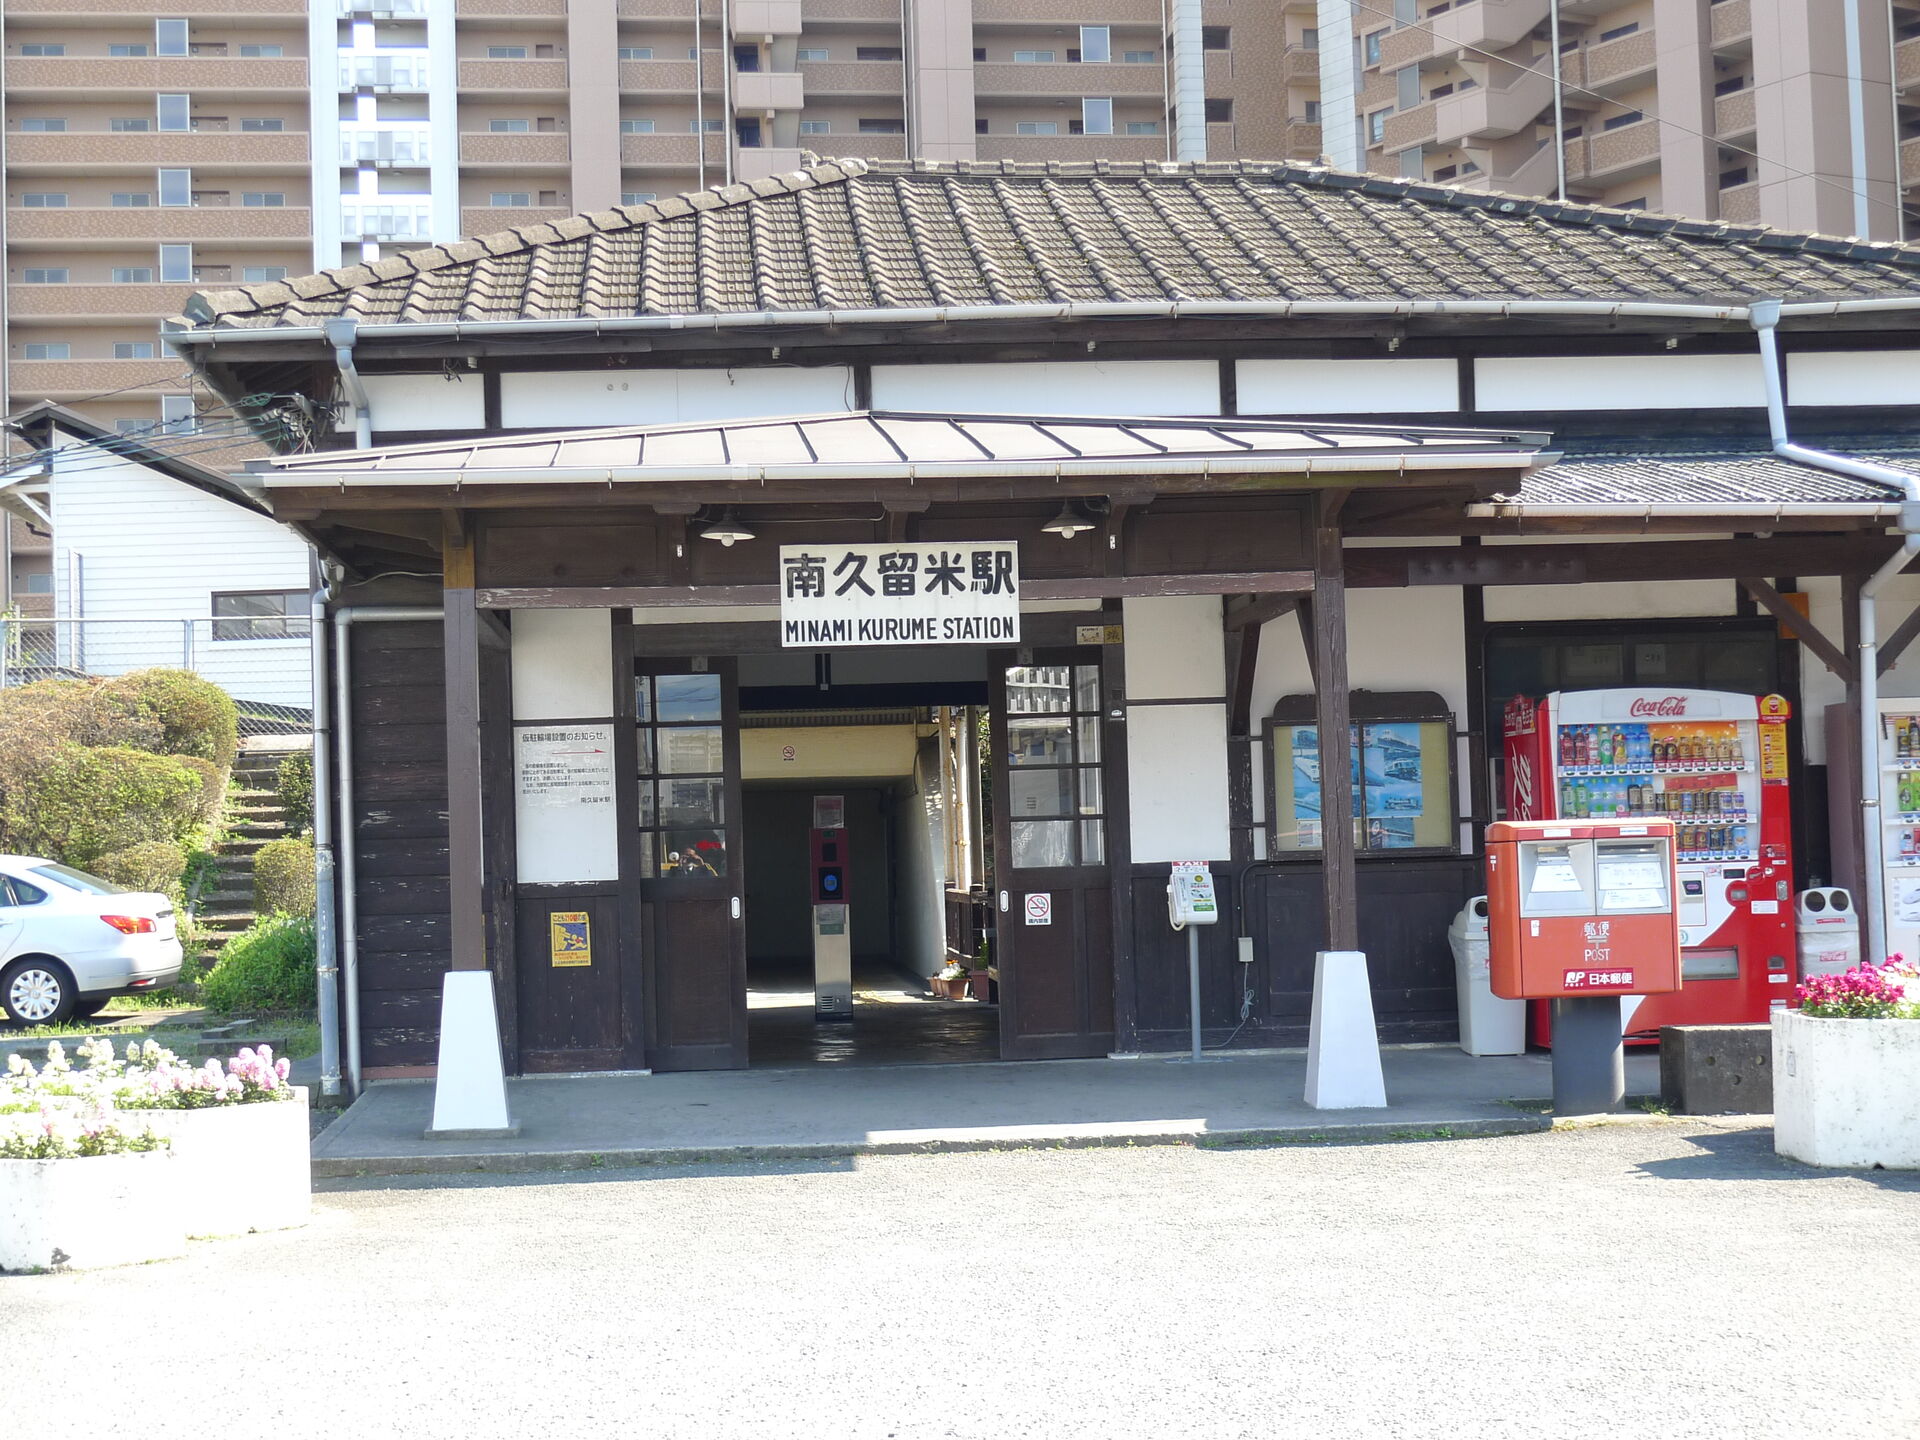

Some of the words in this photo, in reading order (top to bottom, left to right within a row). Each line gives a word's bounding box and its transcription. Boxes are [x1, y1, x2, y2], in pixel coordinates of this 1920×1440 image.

[783, 551, 1016, 598] 南久留米駅
[785, 617, 853, 643] MINAMI
[858, 617, 938, 642] KURUME
[943, 616, 1015, 640] STATION
[1630, 696, 1688, 717] Coca-Cola
[1584, 921, 1610, 936] 郵便
[1584, 949, 1610, 961] POST
[1589, 973, 1632, 984] 日本郵便
